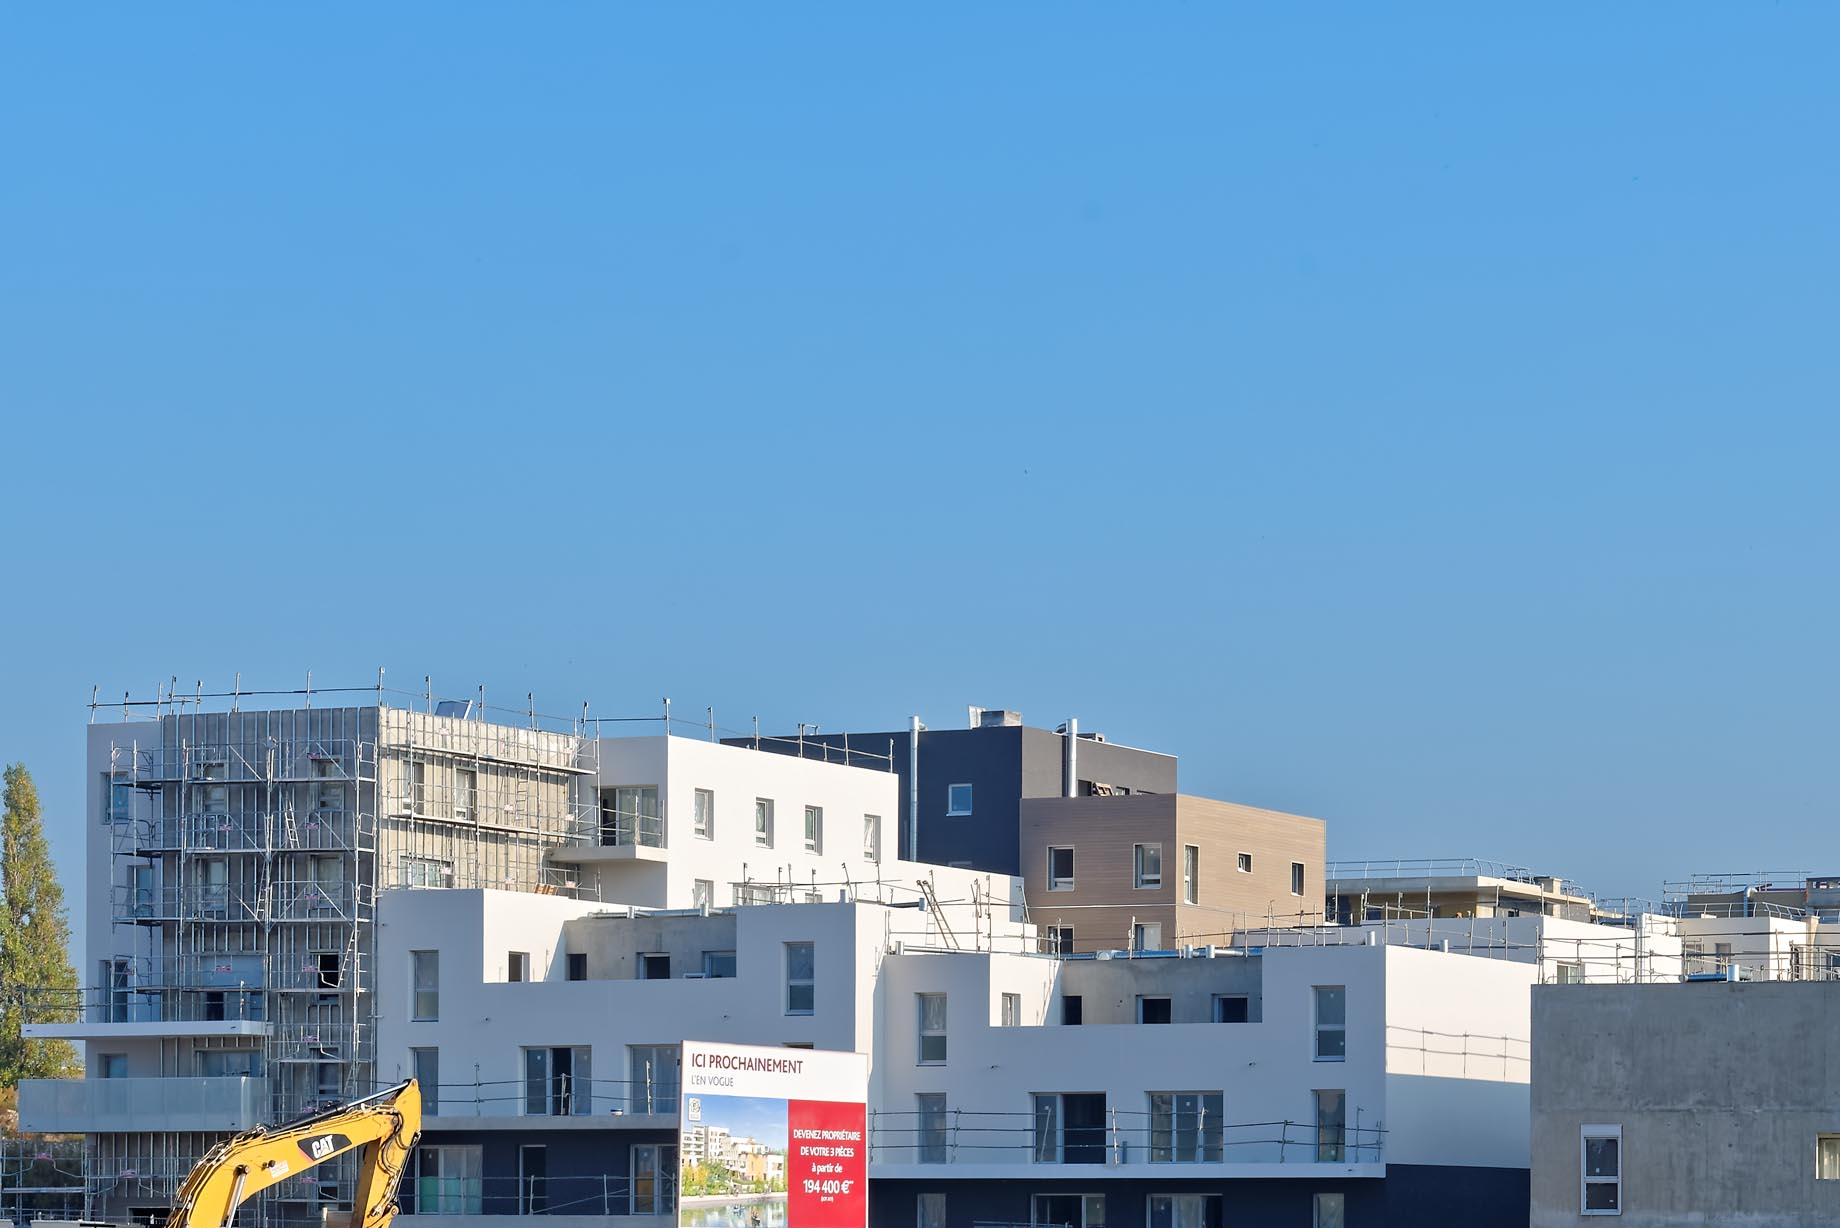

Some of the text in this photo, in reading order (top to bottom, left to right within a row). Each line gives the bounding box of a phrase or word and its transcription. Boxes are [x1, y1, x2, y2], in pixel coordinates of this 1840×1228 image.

[692, 1053, 804, 1074] ICI PROCHAINEMENT
[691, 1075, 734, 1087] L'EN VOGUE
[793, 1129, 861, 1141] DEVENEZ PROPRIÉTAIRE
[311, 1135, 335, 1159] CAT
[800, 1145, 854, 1157] DE VOTRE 3 PIÈCES
[811, 1162, 843, 1175] à partir de
[803, 1179, 820, 1194] 194
[822, 1180, 840, 1194] 400
